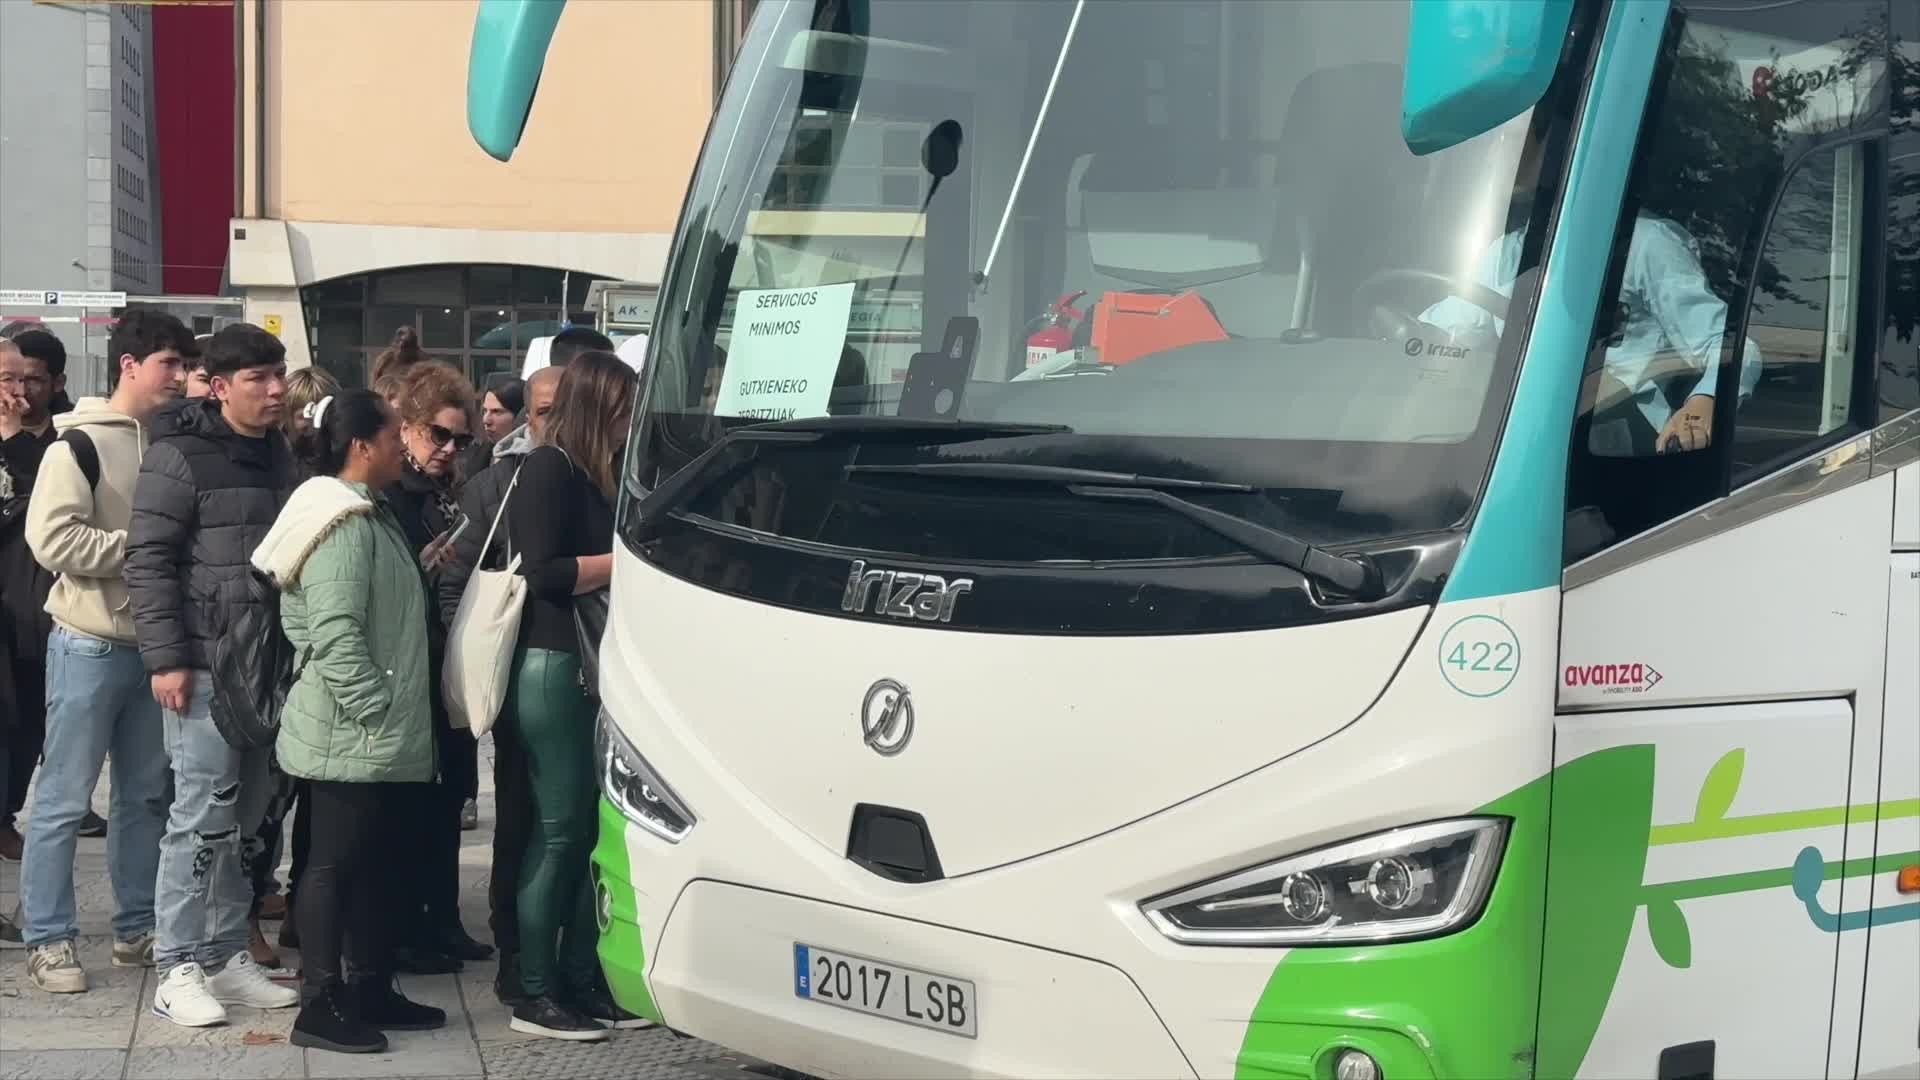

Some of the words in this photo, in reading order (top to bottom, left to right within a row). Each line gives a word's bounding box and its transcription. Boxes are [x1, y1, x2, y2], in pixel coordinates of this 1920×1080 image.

[47, 292, 57, 303] P
[756, 291, 818, 309] SERVICIOS
[618, 305, 639, 316] AK
[749, 320, 801, 336] MINIMOS
[739, 379, 808, 396] GUTXIENEKO
[1447, 641, 1513, 672] 422
[1565, 663, 1643, 687] avanza
[816, 956, 891, 1009] 2017
[904, 975, 966, 1027] LSB
